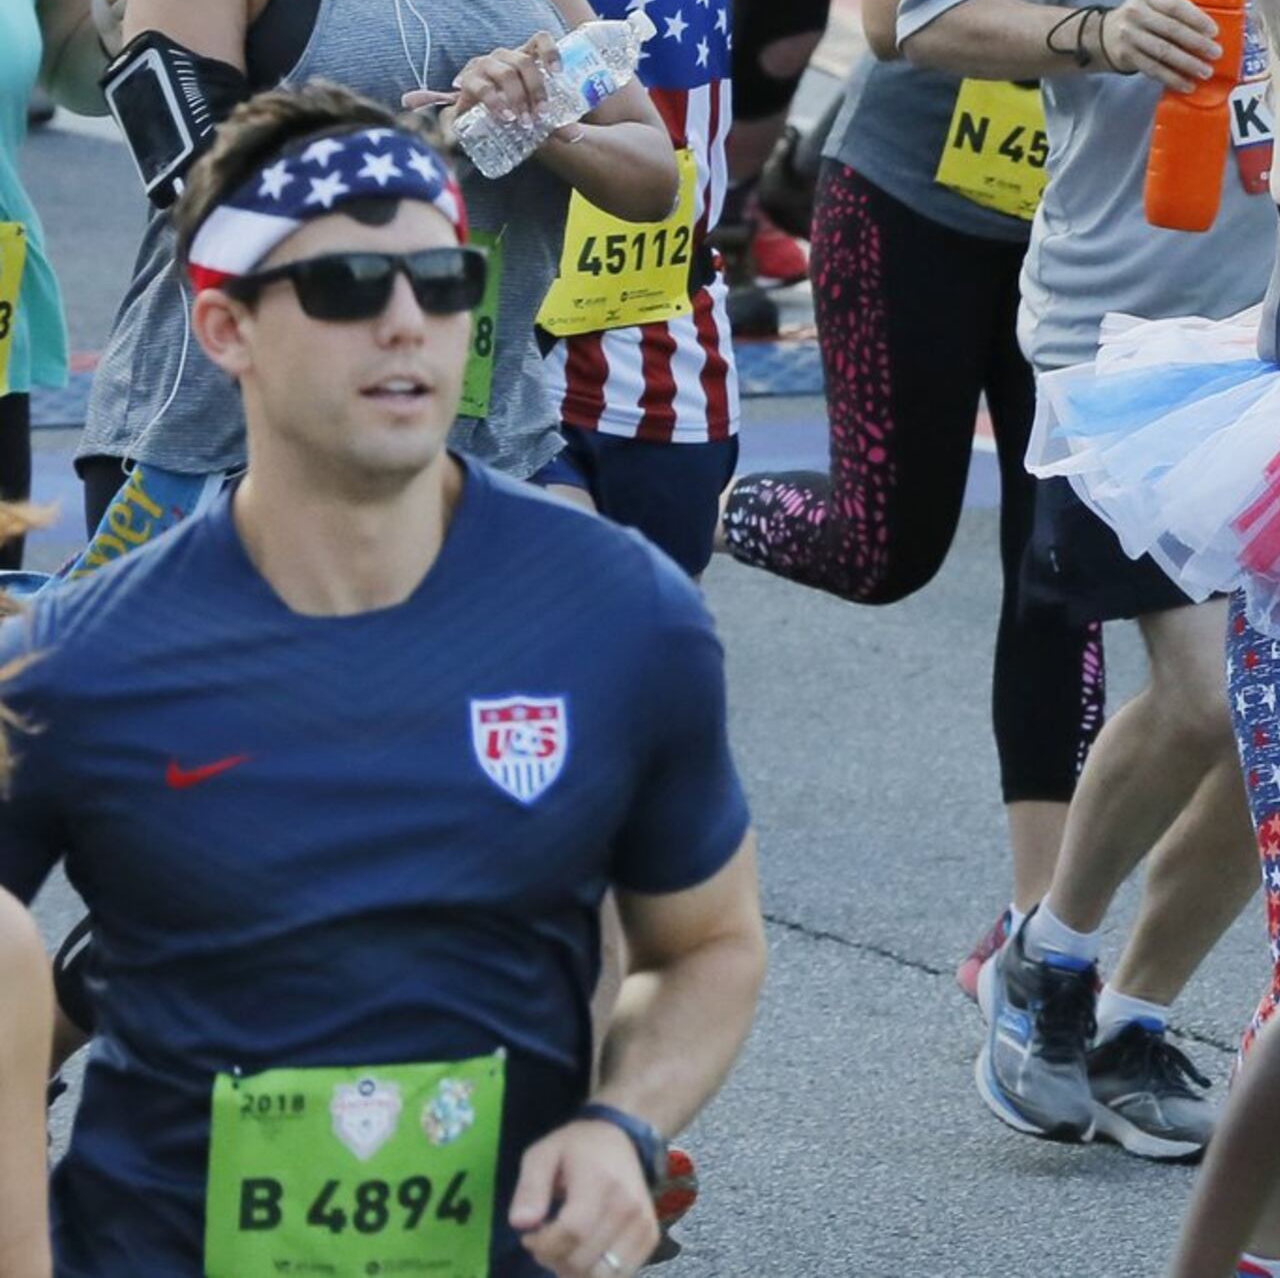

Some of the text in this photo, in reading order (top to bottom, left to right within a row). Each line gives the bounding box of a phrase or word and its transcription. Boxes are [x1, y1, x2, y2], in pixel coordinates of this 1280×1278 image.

[953, 112, 989, 154] N
[1233, 95, 1271, 138] K
[577, 225, 690, 277] 45112
[240, 1093, 305, 1114] 2018
[237, 1170, 473, 1235] B 4894
